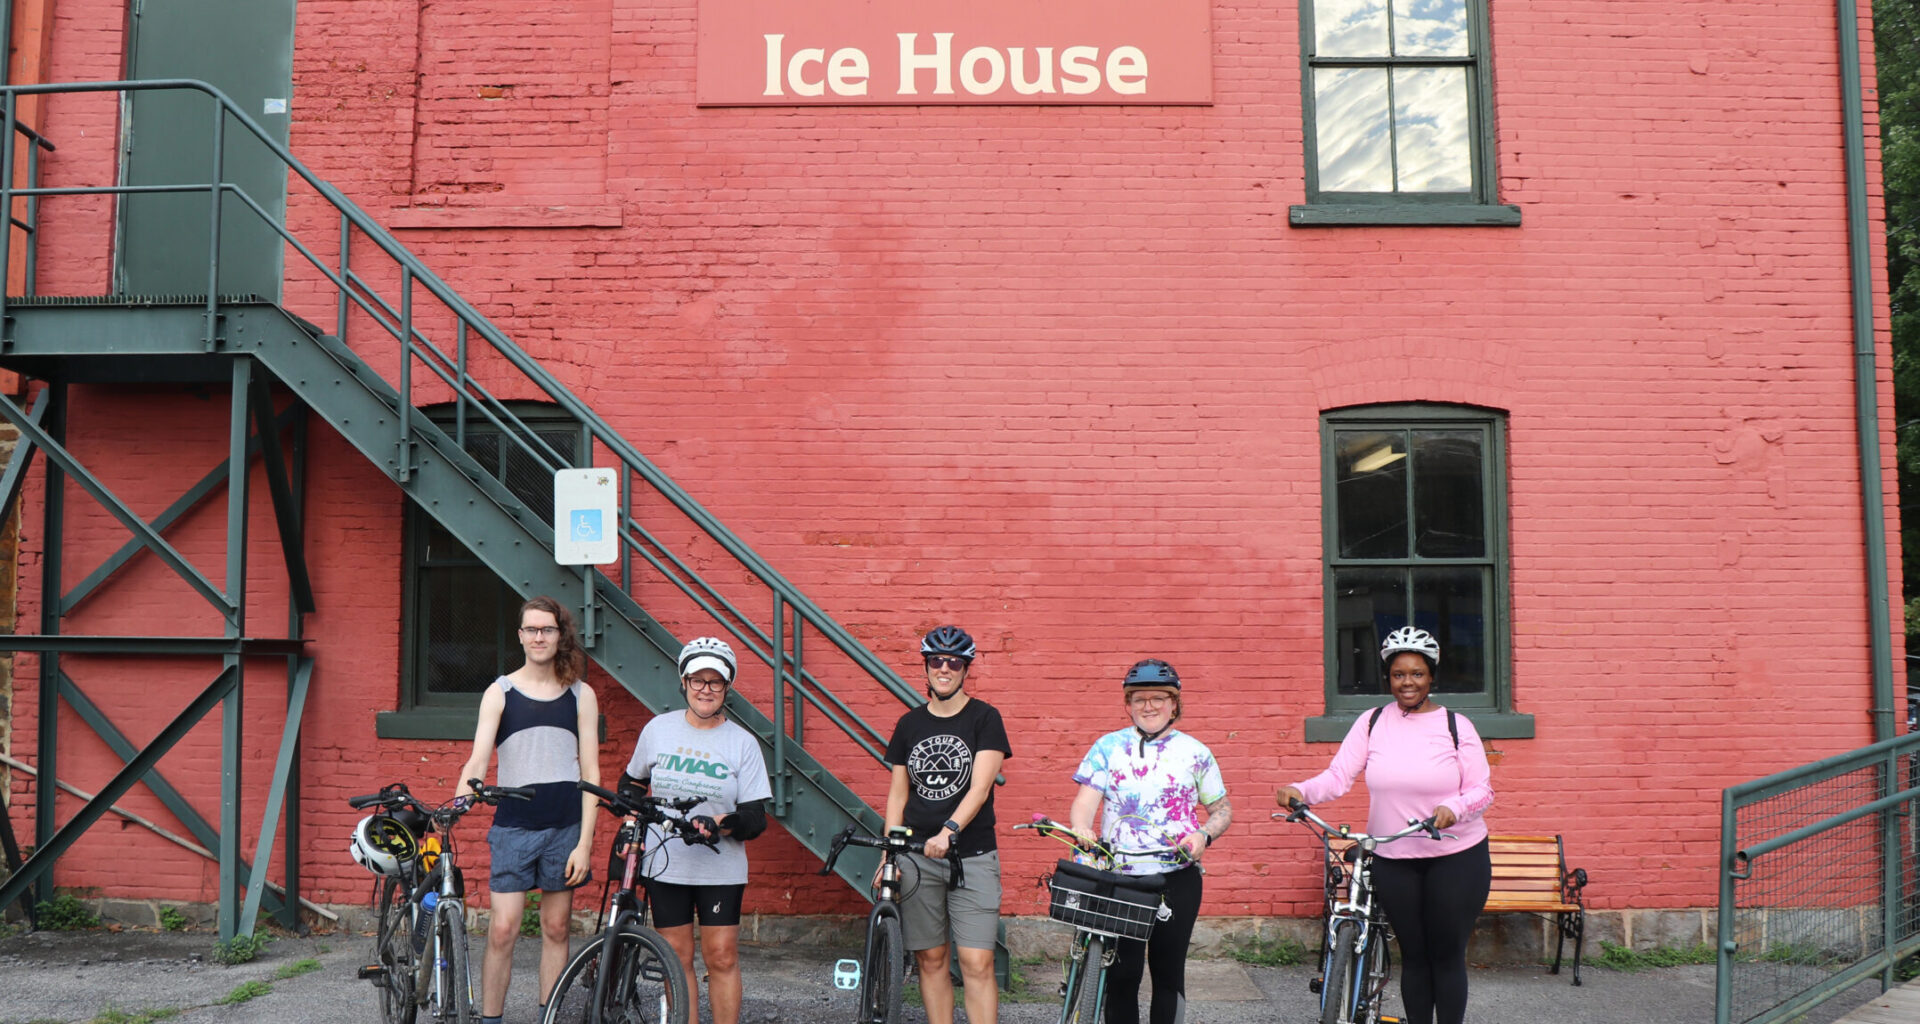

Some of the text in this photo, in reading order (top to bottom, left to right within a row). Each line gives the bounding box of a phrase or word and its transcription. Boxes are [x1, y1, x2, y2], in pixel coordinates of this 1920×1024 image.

[763, 32, 1148, 96] Ice House
[927, 736, 955, 745] YOUR
[955, 742, 971, 764] RIDE
[660, 753, 729, 780] MAC
